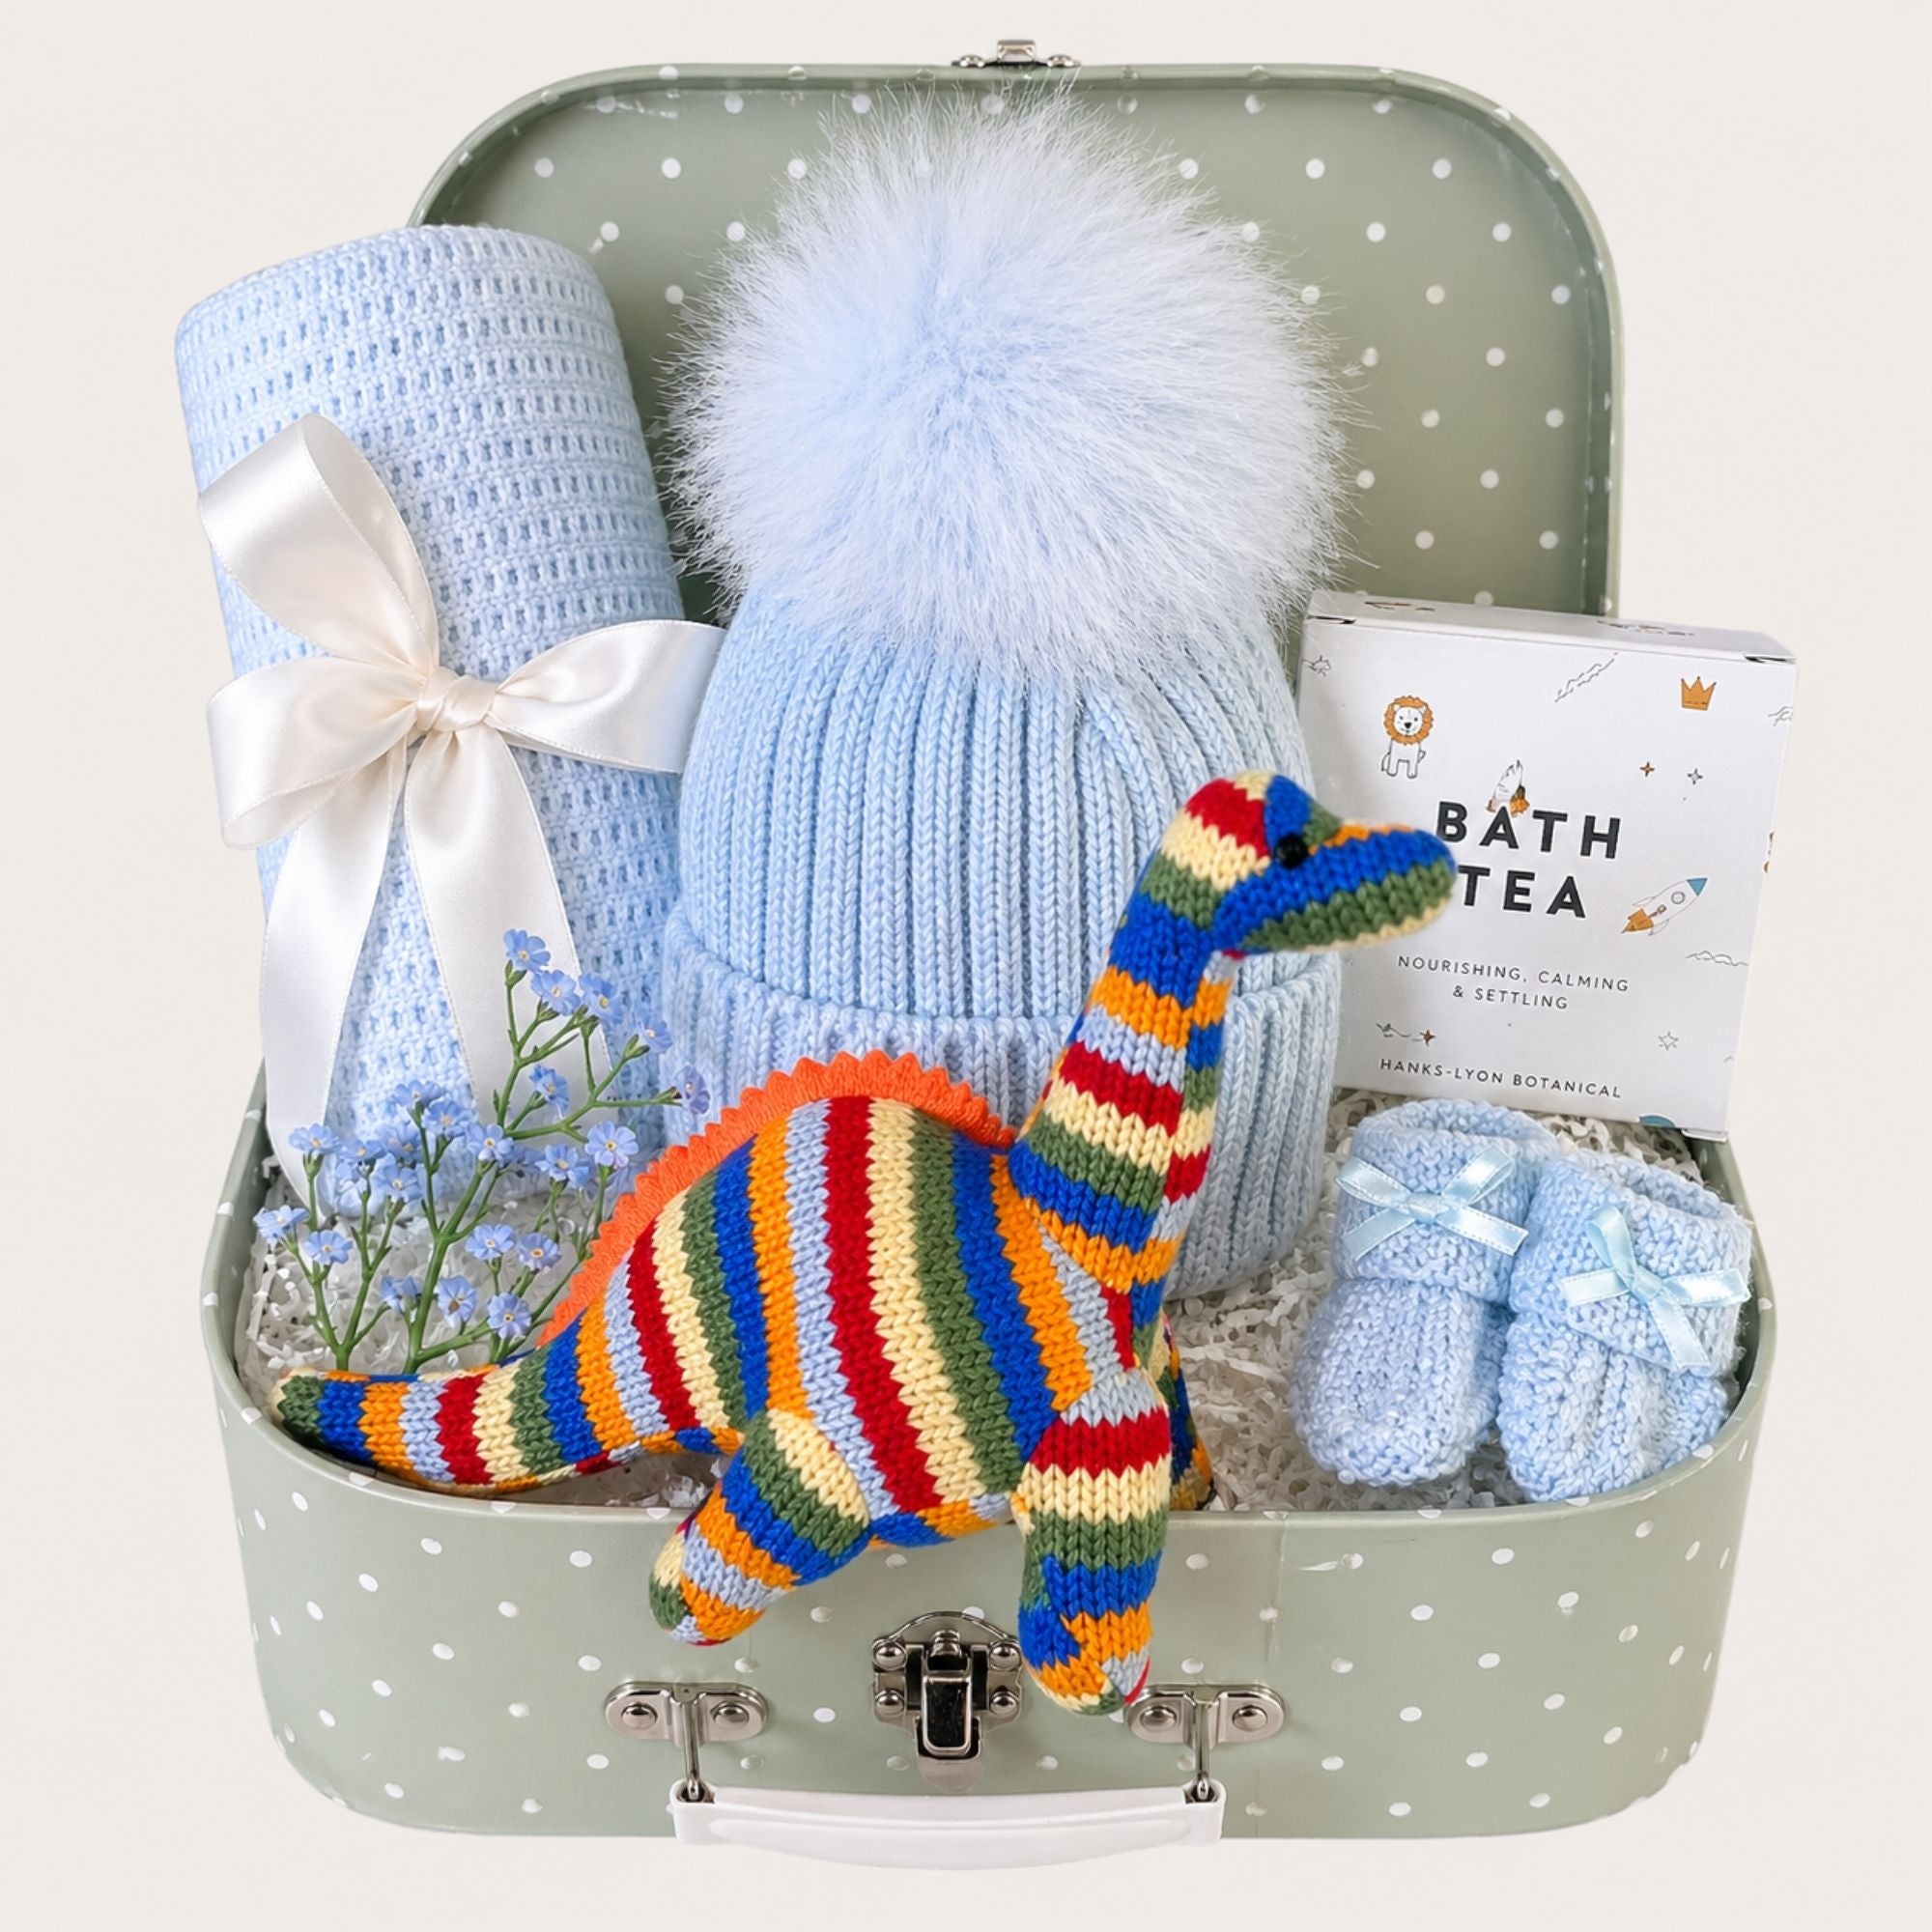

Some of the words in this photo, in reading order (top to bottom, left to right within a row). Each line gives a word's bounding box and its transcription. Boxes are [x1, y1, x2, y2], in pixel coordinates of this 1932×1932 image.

[1437, 801, 1621, 859] BATH
[1457, 866, 1586, 918] TEA
[1398, 955, 1529, 982] NOURISHING,
[1538, 971, 1630, 991] CALMING
[1453, 985, 1464, 999] &
[1474, 987, 1569, 1009] SETTLING
[1380, 1058, 1503, 1084] HANKS-LYON
[1513, 1073, 1622, 1098] BOTANICAL
